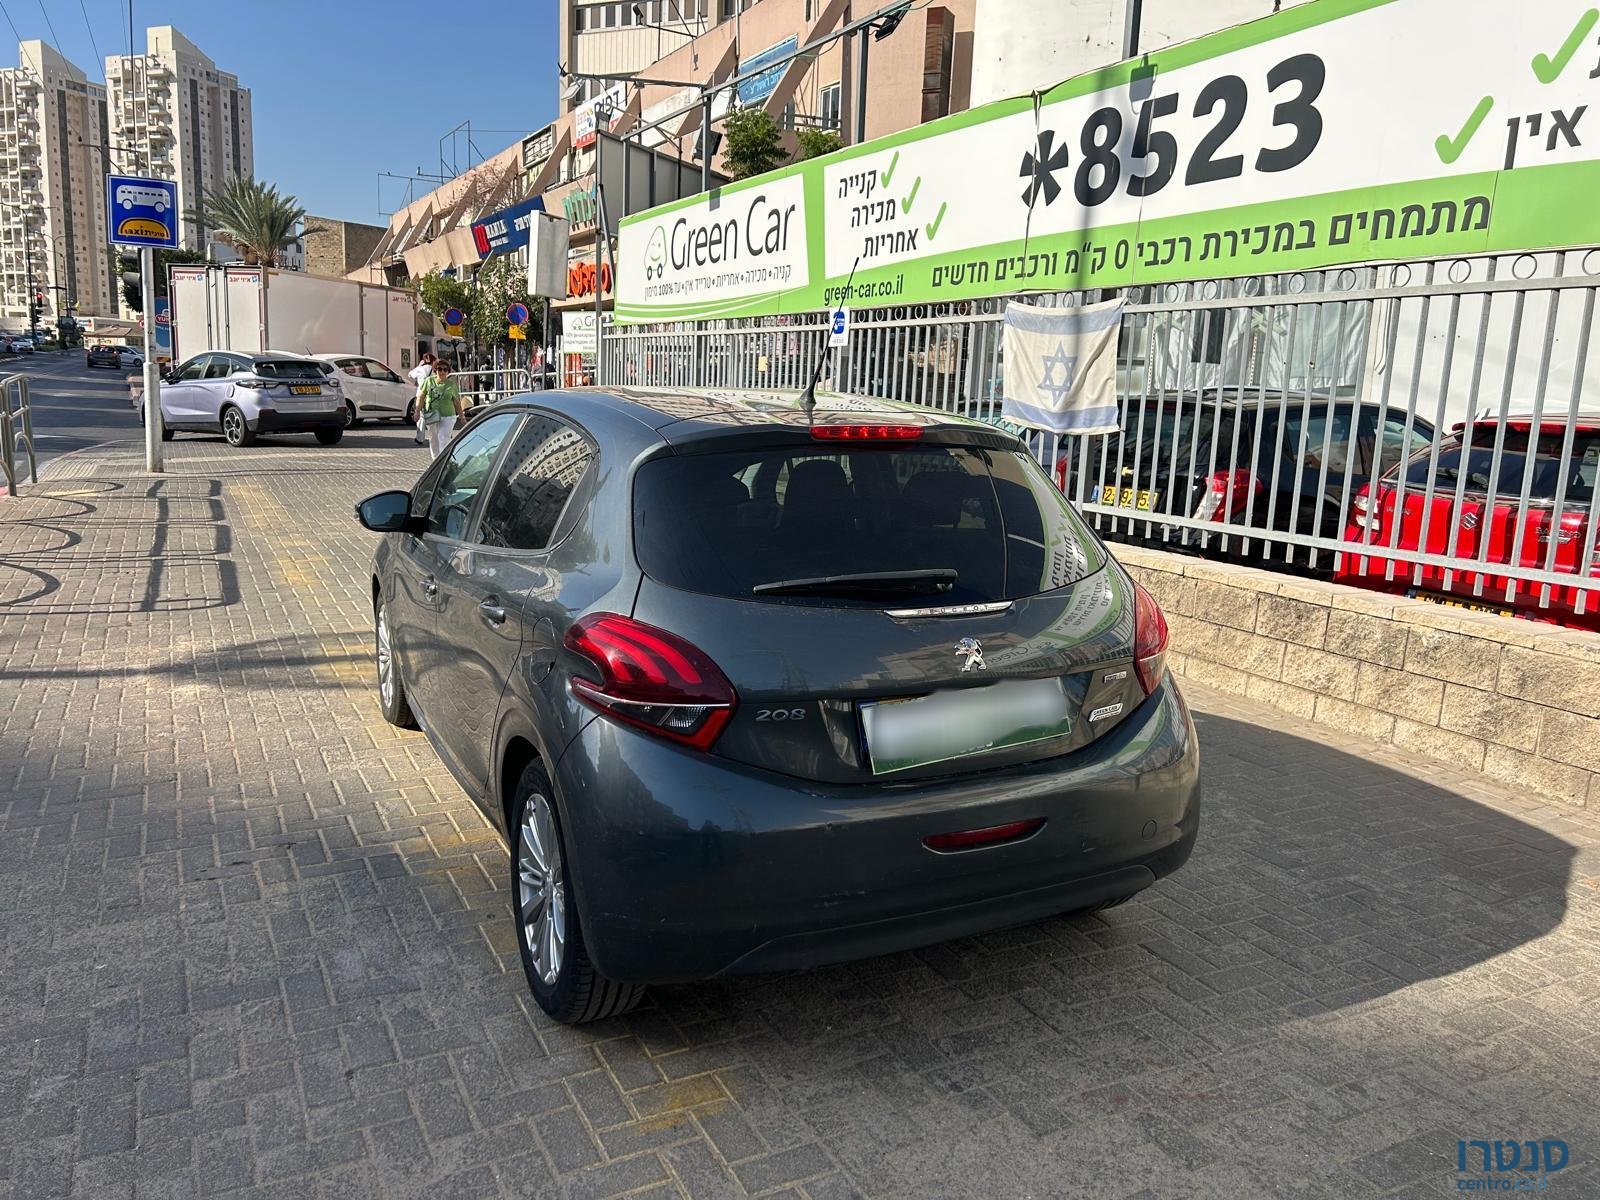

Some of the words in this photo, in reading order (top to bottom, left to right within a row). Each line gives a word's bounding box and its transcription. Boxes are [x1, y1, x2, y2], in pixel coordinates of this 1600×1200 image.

[1503, 104, 1589, 171] אין
[838, 169, 878, 199] קנייה
[851, 198, 896, 228] מכירה
[1327, 195, 1492, 246] מתמחים
[670, 217, 738, 271] Green
[746, 195, 796, 257] Car
[862, 227, 919, 259] אחריות
[1199, 219, 1316, 261] במכירת
[1114, 238, 1129, 270] 0
[1136, 235, 1193, 267] רכבי
[715, 272, 740, 288] אחריות
[745, 268, 767, 283] מכירה
[773, 264, 791, 283] קניה
[931, 260, 989, 287] חדשים
[994, 252, 1058, 282] ורכבים
[824, 273, 904, 306] green-car.co.il
[755, 708, 806, 721] 208
